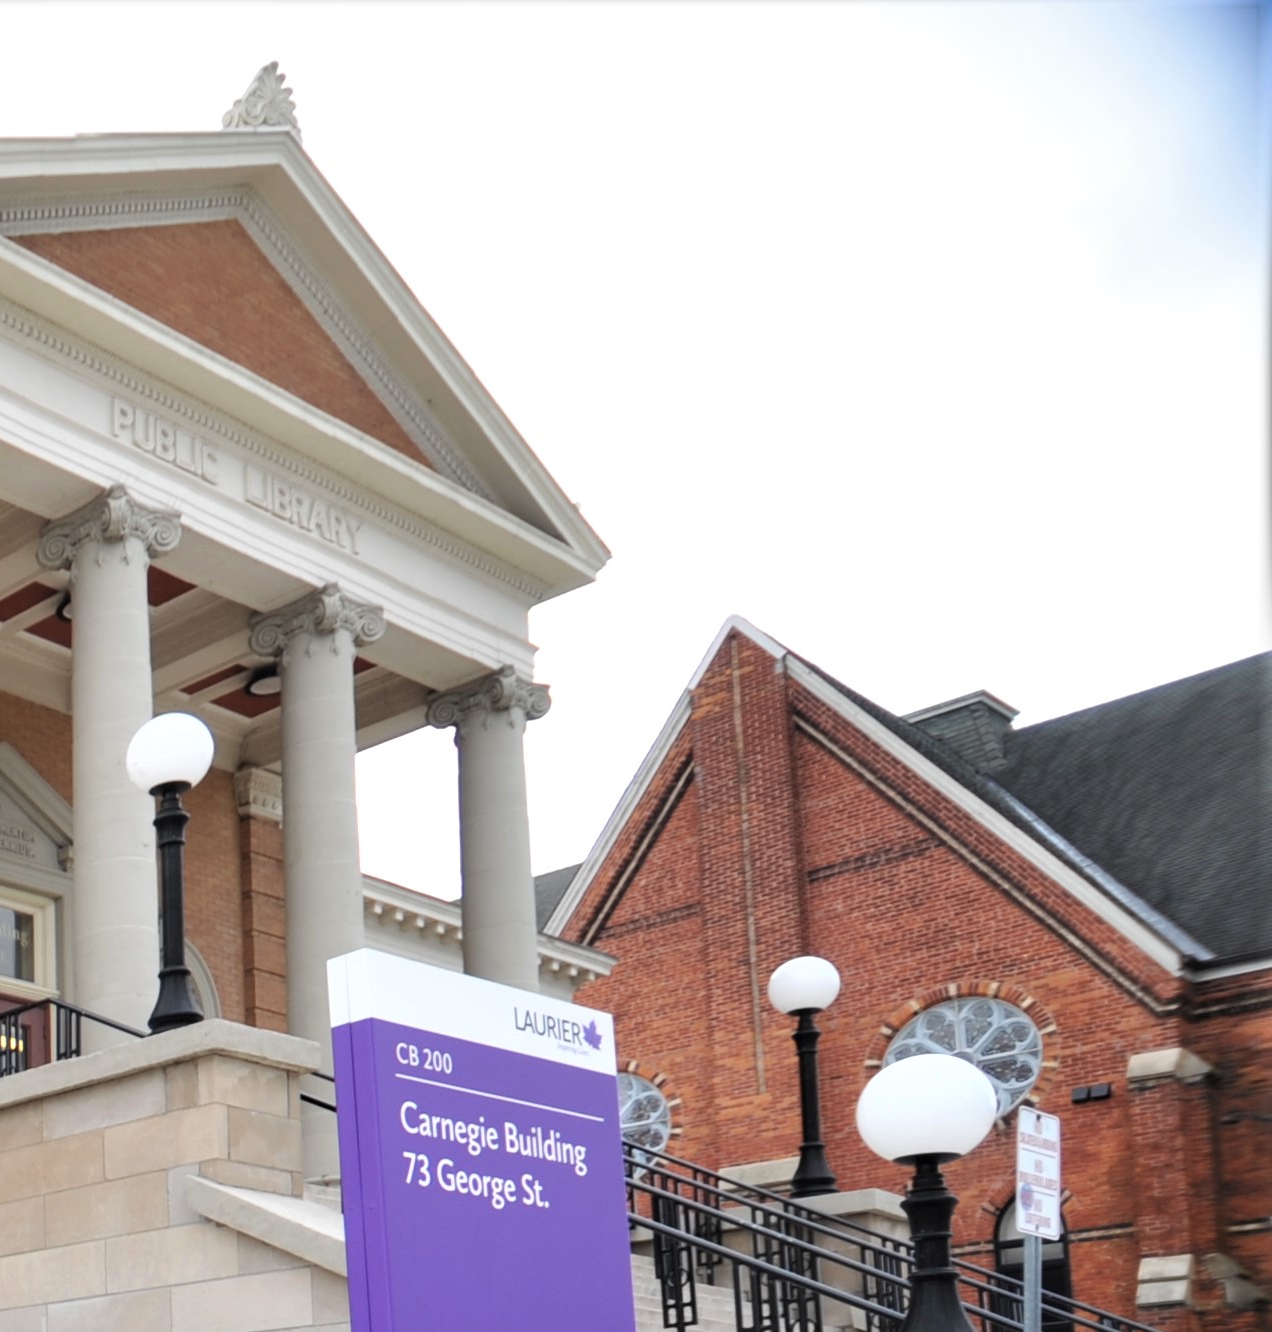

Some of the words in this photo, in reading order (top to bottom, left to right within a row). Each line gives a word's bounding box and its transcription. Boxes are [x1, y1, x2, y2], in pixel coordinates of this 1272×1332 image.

[112, 396, 218, 486] PUBLIC
[243, 461, 363, 556] LIBRARY
[513, 1006, 583, 1047] LAURIER
[396, 1041, 420, 1067] CB
[422, 1048, 453, 1075] 200
[399, 1100, 499, 1157] Carnegie
[504, 1121, 589, 1177] Building
[402, 1151, 432, 1188] 73
[436, 1158, 517, 1210] George
[520, 1173, 551, 1209] St.
